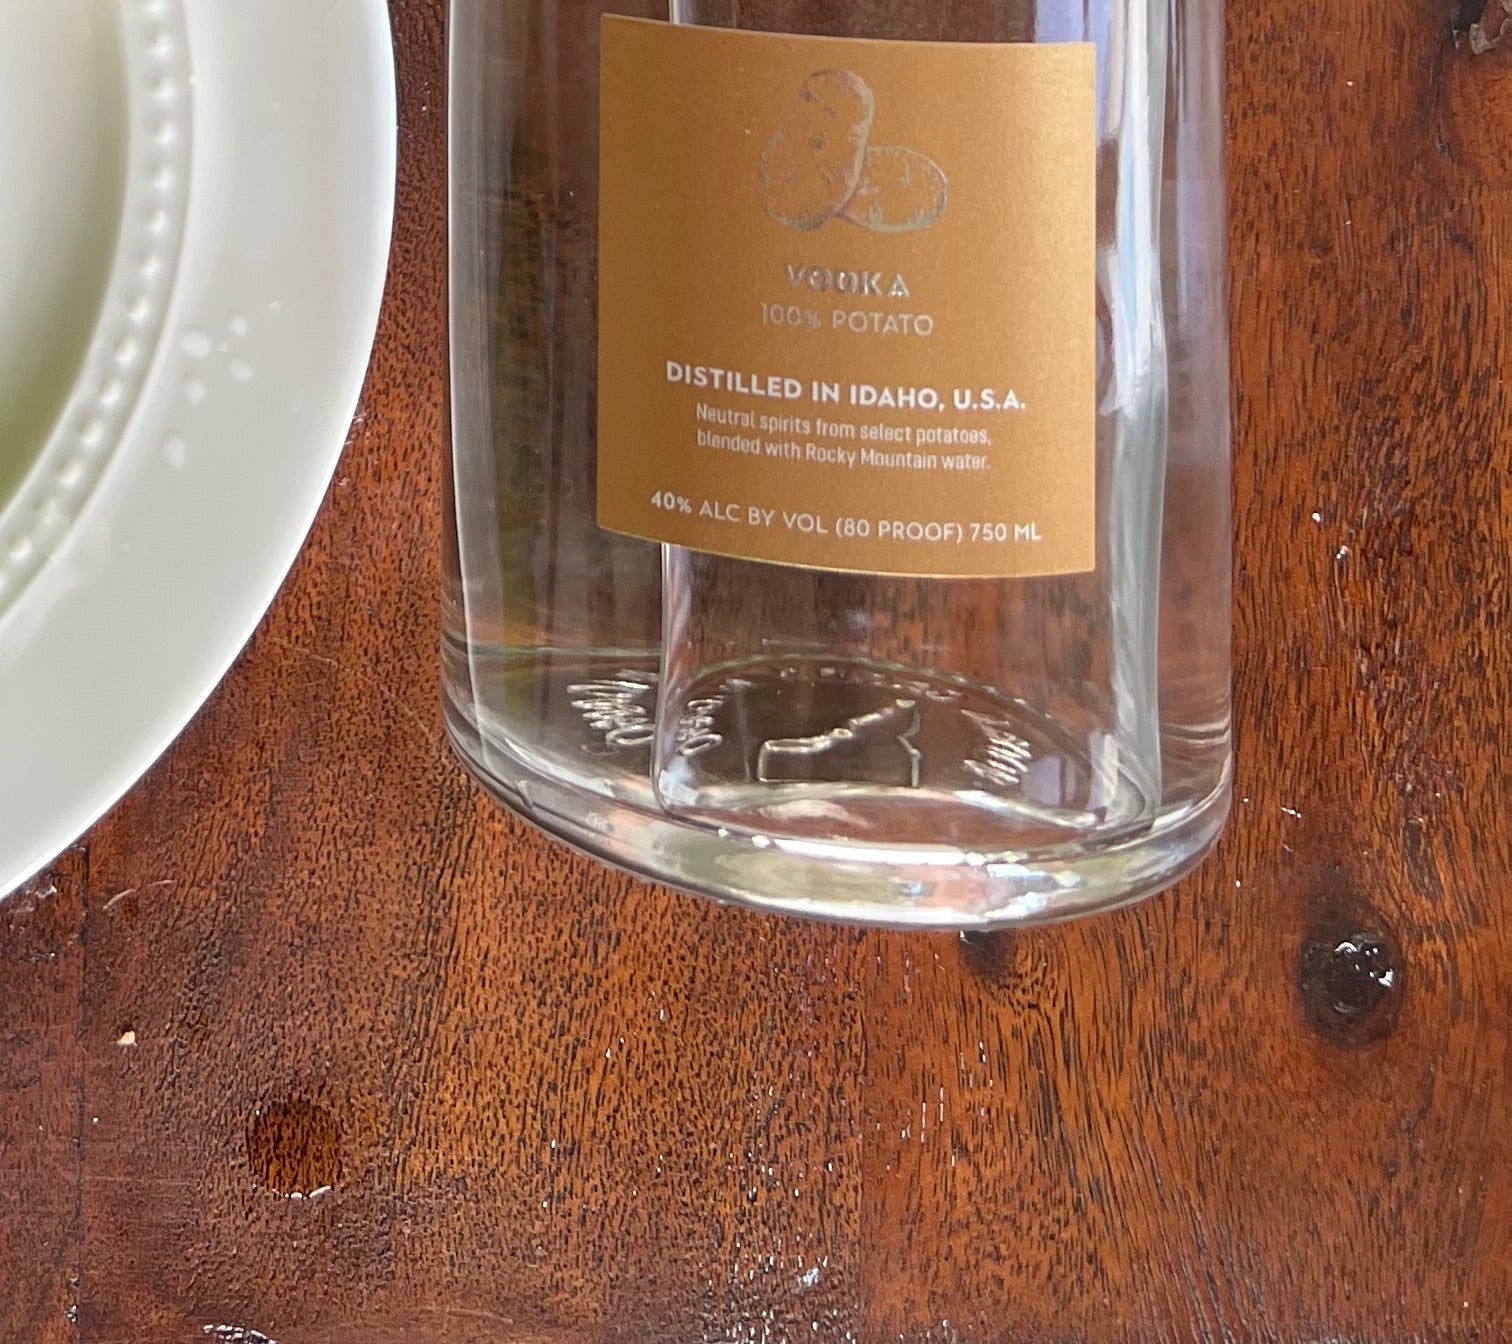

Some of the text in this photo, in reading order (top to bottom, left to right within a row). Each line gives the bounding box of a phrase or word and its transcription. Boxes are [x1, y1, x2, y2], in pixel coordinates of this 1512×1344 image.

[786, 264, 911, 298] VODKA
[760, 302, 935, 336] 100% POTATO
[665, 359, 1027, 411] DISTILLED IN IDAHO, U.S.A.
[695, 402, 992, 447] Neutral spirits from select potatoes,
[696, 427, 991, 471] blended with Rocky Mountain water.
[650, 489, 1042, 544] 40% ALC BY VOL (80 PROOF) 750 ML
